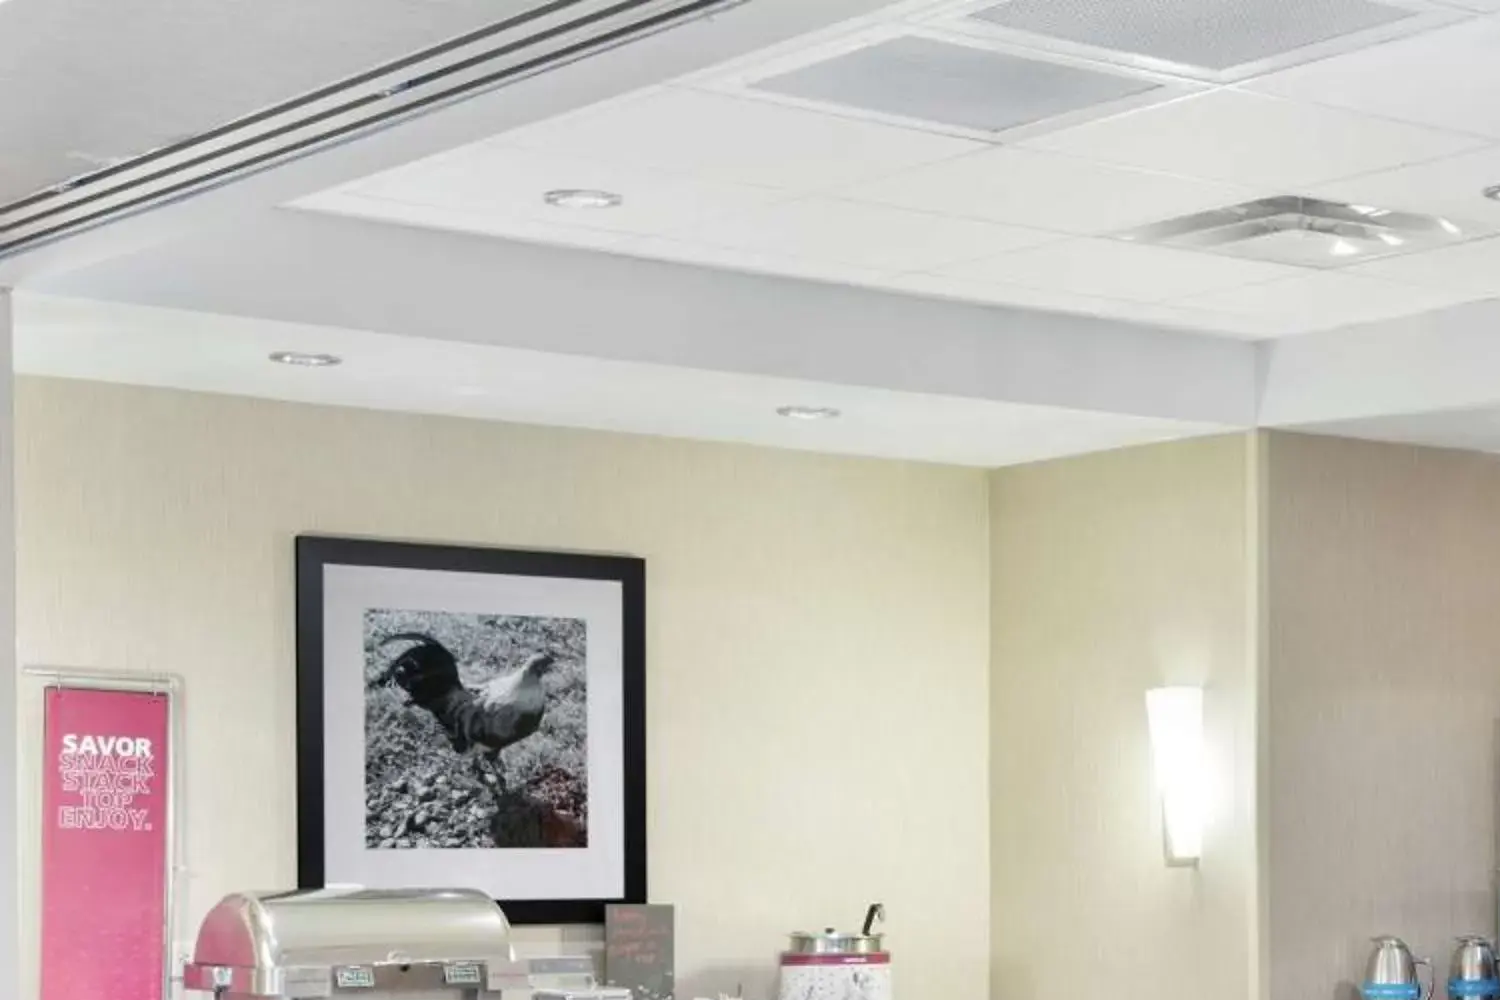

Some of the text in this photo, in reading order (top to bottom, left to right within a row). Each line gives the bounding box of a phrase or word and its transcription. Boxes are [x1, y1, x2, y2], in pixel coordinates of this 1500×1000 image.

[63, 734, 152, 757] SAVOR
[59, 753, 154, 776] SNACK
[62, 769, 150, 794] STACK
[79, 785, 133, 808] TOP
[58, 806, 152, 830] ENJOY.
